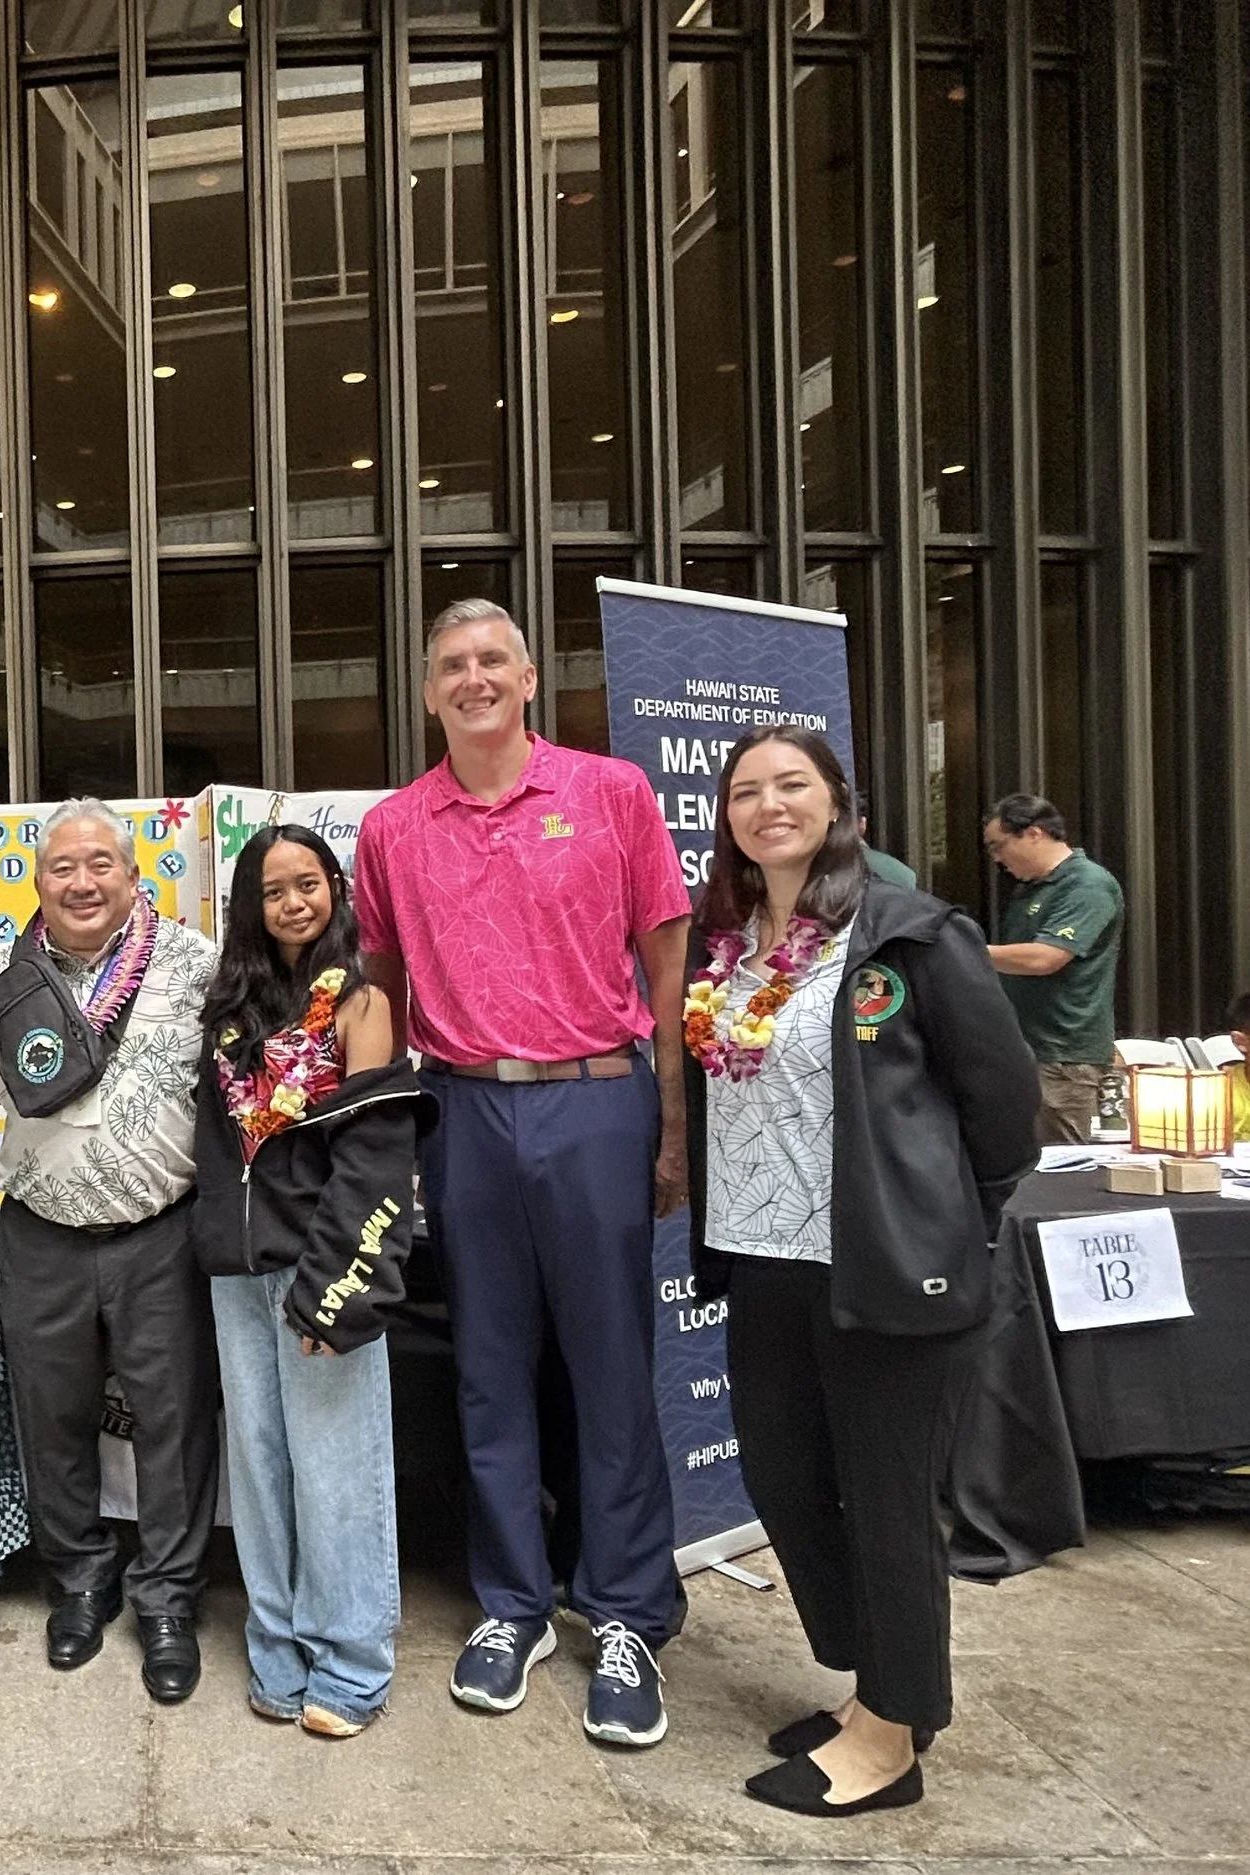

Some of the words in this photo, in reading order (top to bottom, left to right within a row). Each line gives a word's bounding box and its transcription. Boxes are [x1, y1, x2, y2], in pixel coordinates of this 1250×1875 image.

[739, 684, 781, 705] STATE
[634, 698, 730, 722] DEPARTMENT
[732, 707, 750, 725] OF
[753, 709, 827, 732] EDUCATION
[1078, 1233, 1139, 1258] TABLE
[1096, 1259, 1134, 1302] 13
[690, 1378, 721, 1399] Why
[686, 1438, 739, 1470] #HIPUB
